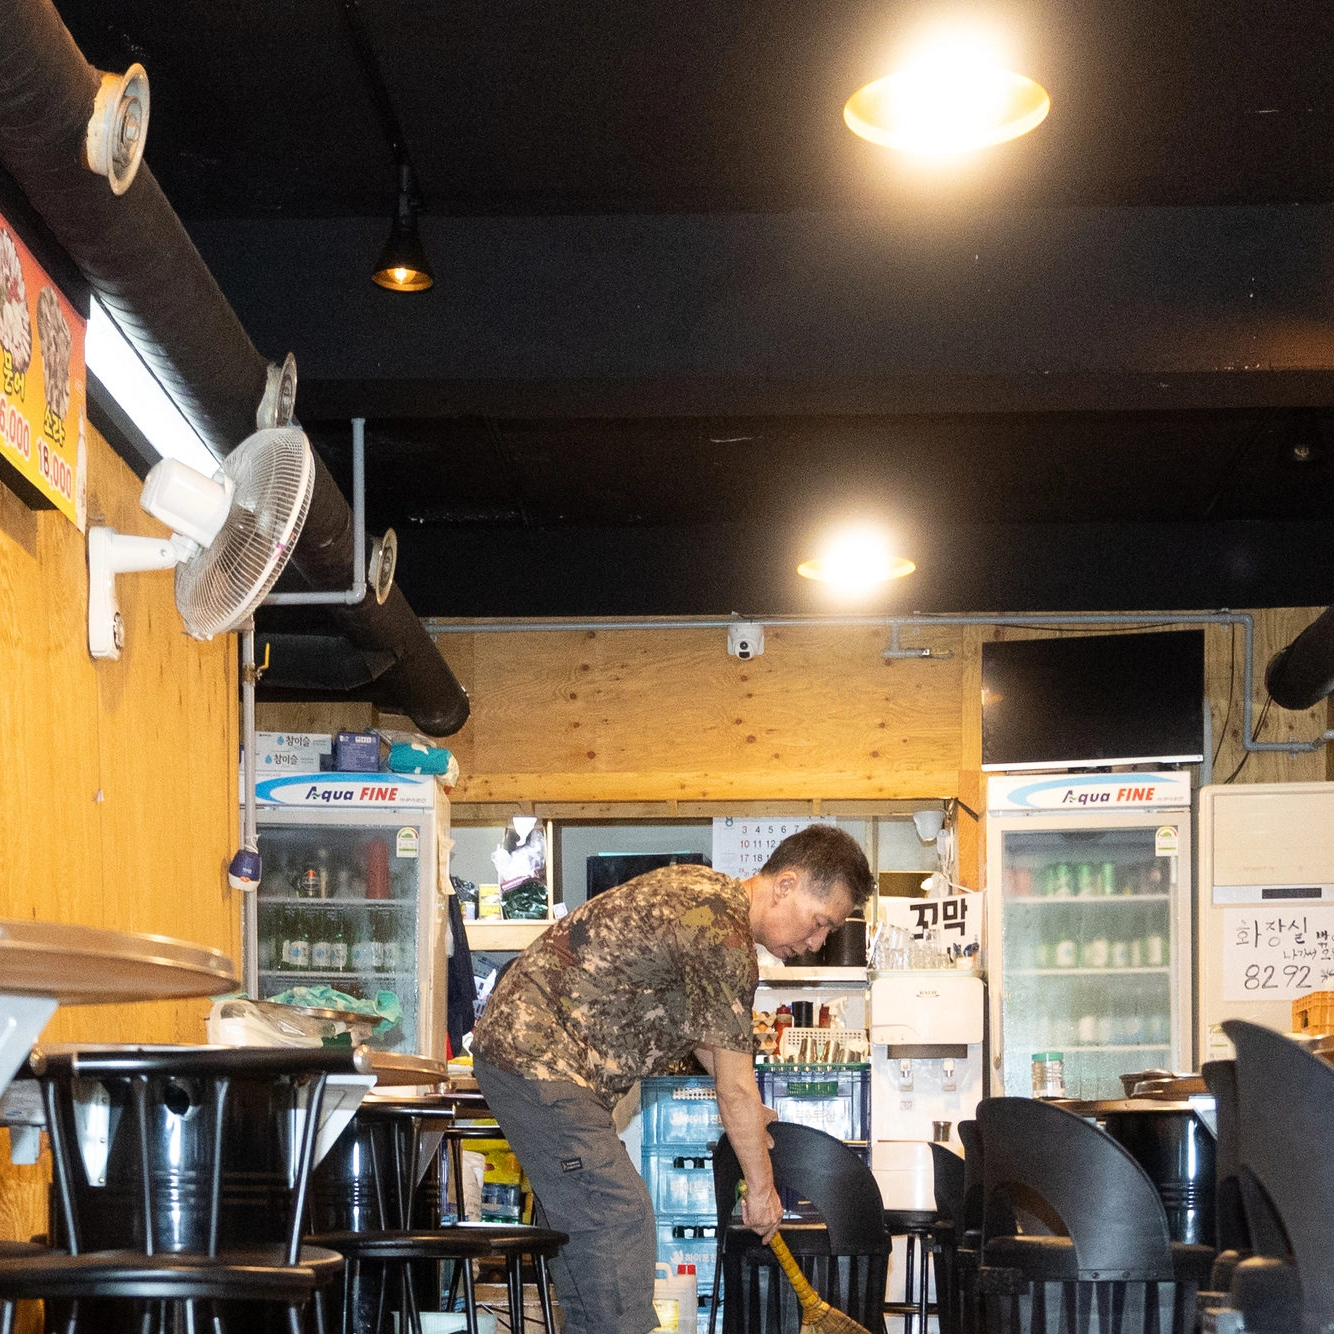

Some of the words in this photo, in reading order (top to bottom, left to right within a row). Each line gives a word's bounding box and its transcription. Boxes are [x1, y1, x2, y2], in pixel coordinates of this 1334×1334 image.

[2, 348, 25, 403] 문어
[43, 402, 66, 447] 소라
[38, 440, 73, 502] 18,000
[286, 736, 311, 747] 참이슬
[274, 754, 298, 765] 참이슬
[305, 786, 354, 802] Aqua
[360, 787, 398, 801] FINE
[1062, 790, 1110, 805] Aqua
[1116, 787, 1155, 802] FINE
[742, 826, 748, 834] 3
[768, 826, 774, 834] 5
[740, 840, 750, 848] 10
[753, 840, 762, 848] 11
[766, 840, 776, 848] 12
[740, 854, 749, 862] 17
[753, 854, 762, 862] 18
[910, 898, 967, 940] 꼬막
[1236, 917, 1307, 948] 화장실
